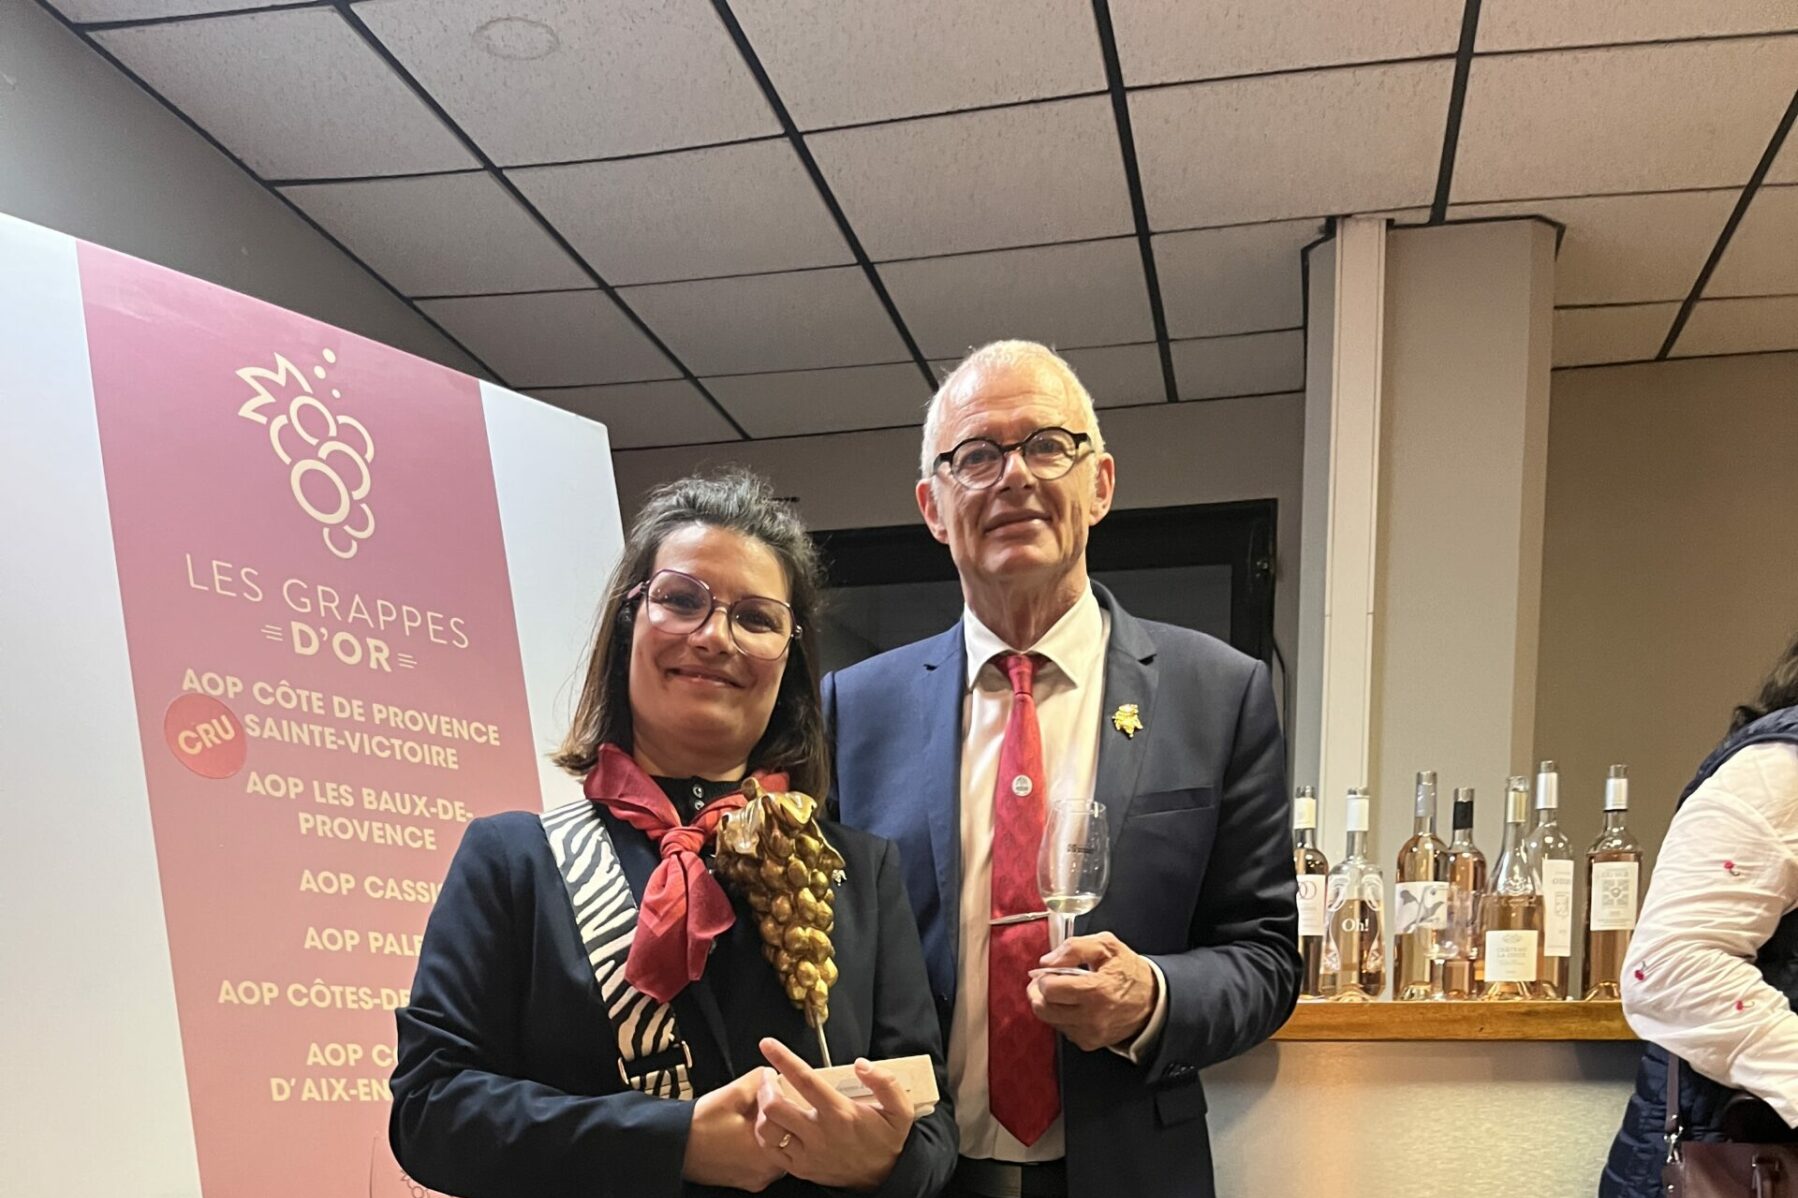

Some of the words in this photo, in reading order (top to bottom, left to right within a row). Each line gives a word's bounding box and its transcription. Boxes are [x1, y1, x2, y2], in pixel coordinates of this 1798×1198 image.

[186, 553, 263, 601] LES
[283, 579, 469, 648] GRAPPES
[290, 621, 392, 672] D'OR
[182, 668, 243, 698] AOP
[253, 680, 324, 714] CÔTE
[332, 696, 365, 722] DE
[373, 703, 500, 746] PROVENCE
[178, 715, 235, 755] CRU
[244, 714, 459, 770] SAINTE-VICTOIRE
[246, 771, 304, 799] AOP
[313, 780, 353, 807] LES
[299, 812, 436, 850] PROVENCE
[300, 869, 355, 896] AOP
[364, 876, 443, 903] CASSI
[304, 927, 360, 951] AOP
[1341, 918, 1369, 932] Oh!
[218, 980, 279, 1006] AOP
[306, 1043, 363, 1067] AOP
[371, 1044, 398, 1067] C
